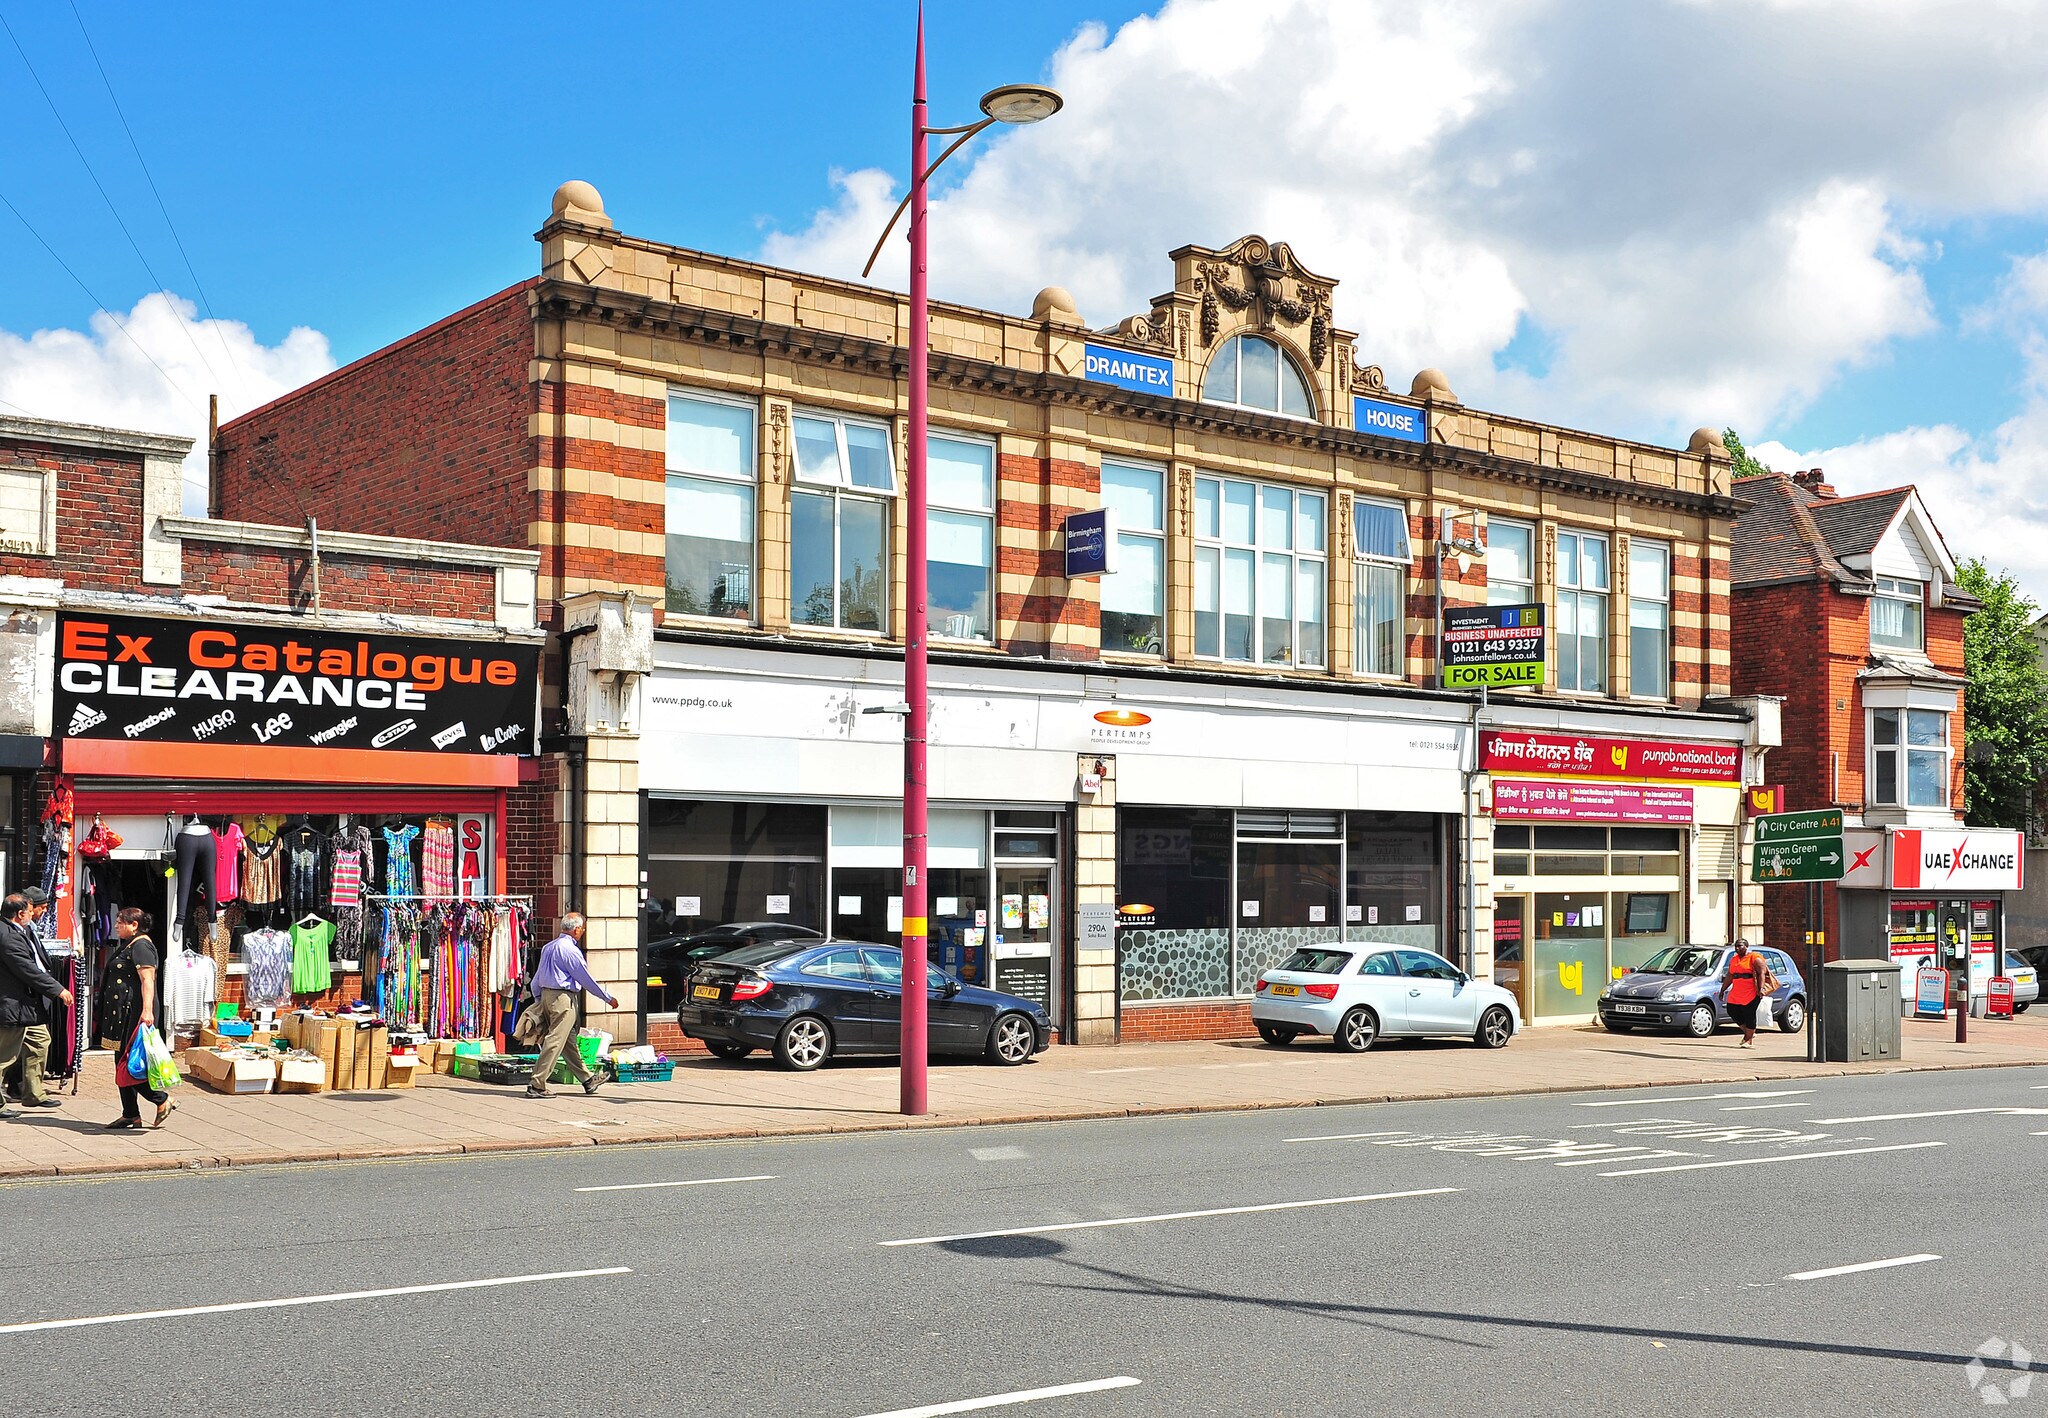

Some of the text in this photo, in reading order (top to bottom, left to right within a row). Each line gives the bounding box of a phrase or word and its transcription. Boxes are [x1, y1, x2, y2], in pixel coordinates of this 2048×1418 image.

[1086, 355, 1169, 387] DRAMTEX
[1367, 409, 1413, 432] HOUSE
[1068, 527, 1102, 539] Birmingham
[1451, 611, 1532, 626] INVESTMENT J F
[1445, 627, 1542, 641] BUSINESS UNAFFECTED
[1452, 638, 1538, 653] 0121 643 9337
[62, 620, 517, 691] Ex Catalogue
[1453, 651, 1537, 664] johnsonfellows.co.uk
[1453, 666, 1536, 683] FOR SALE
[60, 661, 426, 711] CLEARANCE
[652, 696, 733, 709] www.ppdg.co.uk
[68, 708, 108, 736] adidas
[123, 706, 176, 739] Reebok
[192, 709, 237, 738] HUGO
[251, 712, 293, 743] Lee
[309, 715, 358, 746] Wrangler
[1091, 729, 1152, 739] PERTEMPS
[1642, 748, 1737, 766] punjab national bank
[1084, 779, 1100, 788] Abel
[1770, 817, 1840, 832] City Centre A 41
[1760, 844, 1818, 856] Winson Green
[1760, 856, 1802, 867] Bewood
[908, 866, 915, 876] 7
[1760, 867, 1793, 877] A 440
[1087, 924, 1107, 932] 290A
